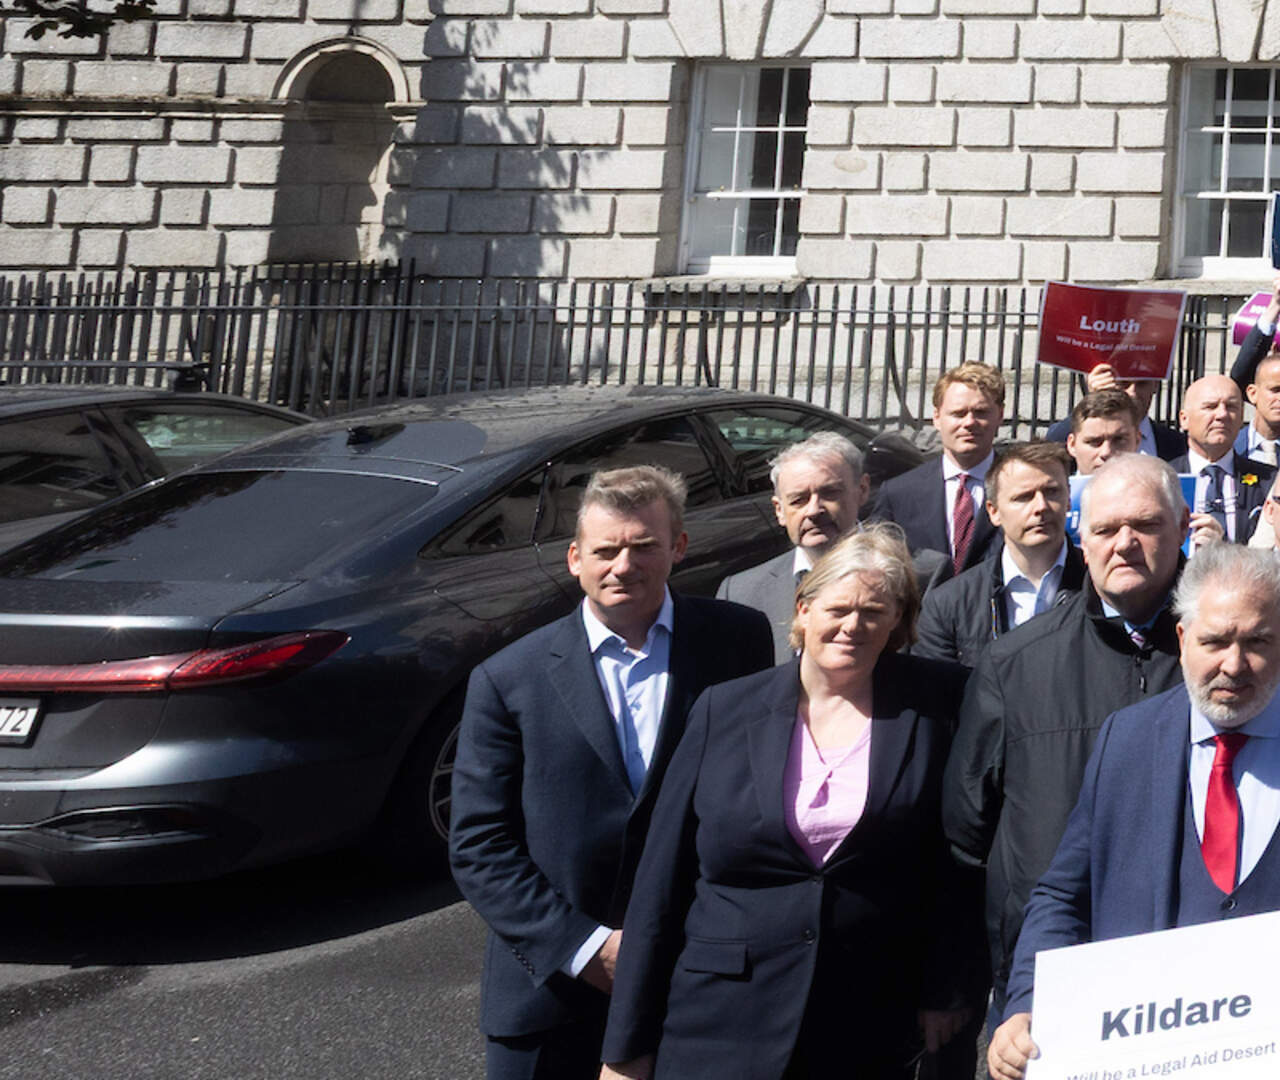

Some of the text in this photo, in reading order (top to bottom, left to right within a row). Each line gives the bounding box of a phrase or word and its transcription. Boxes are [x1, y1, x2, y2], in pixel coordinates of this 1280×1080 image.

[1080, 315, 1141, 333] Louth
[1100, 994, 1252, 1041] Kildare
[1127, 1069, 1136, 1078] a
[1141, 1056, 1187, 1076] Legal
[1191, 1050, 1218, 1067] Aid
[1222, 1041, 1277, 1063] Desert
